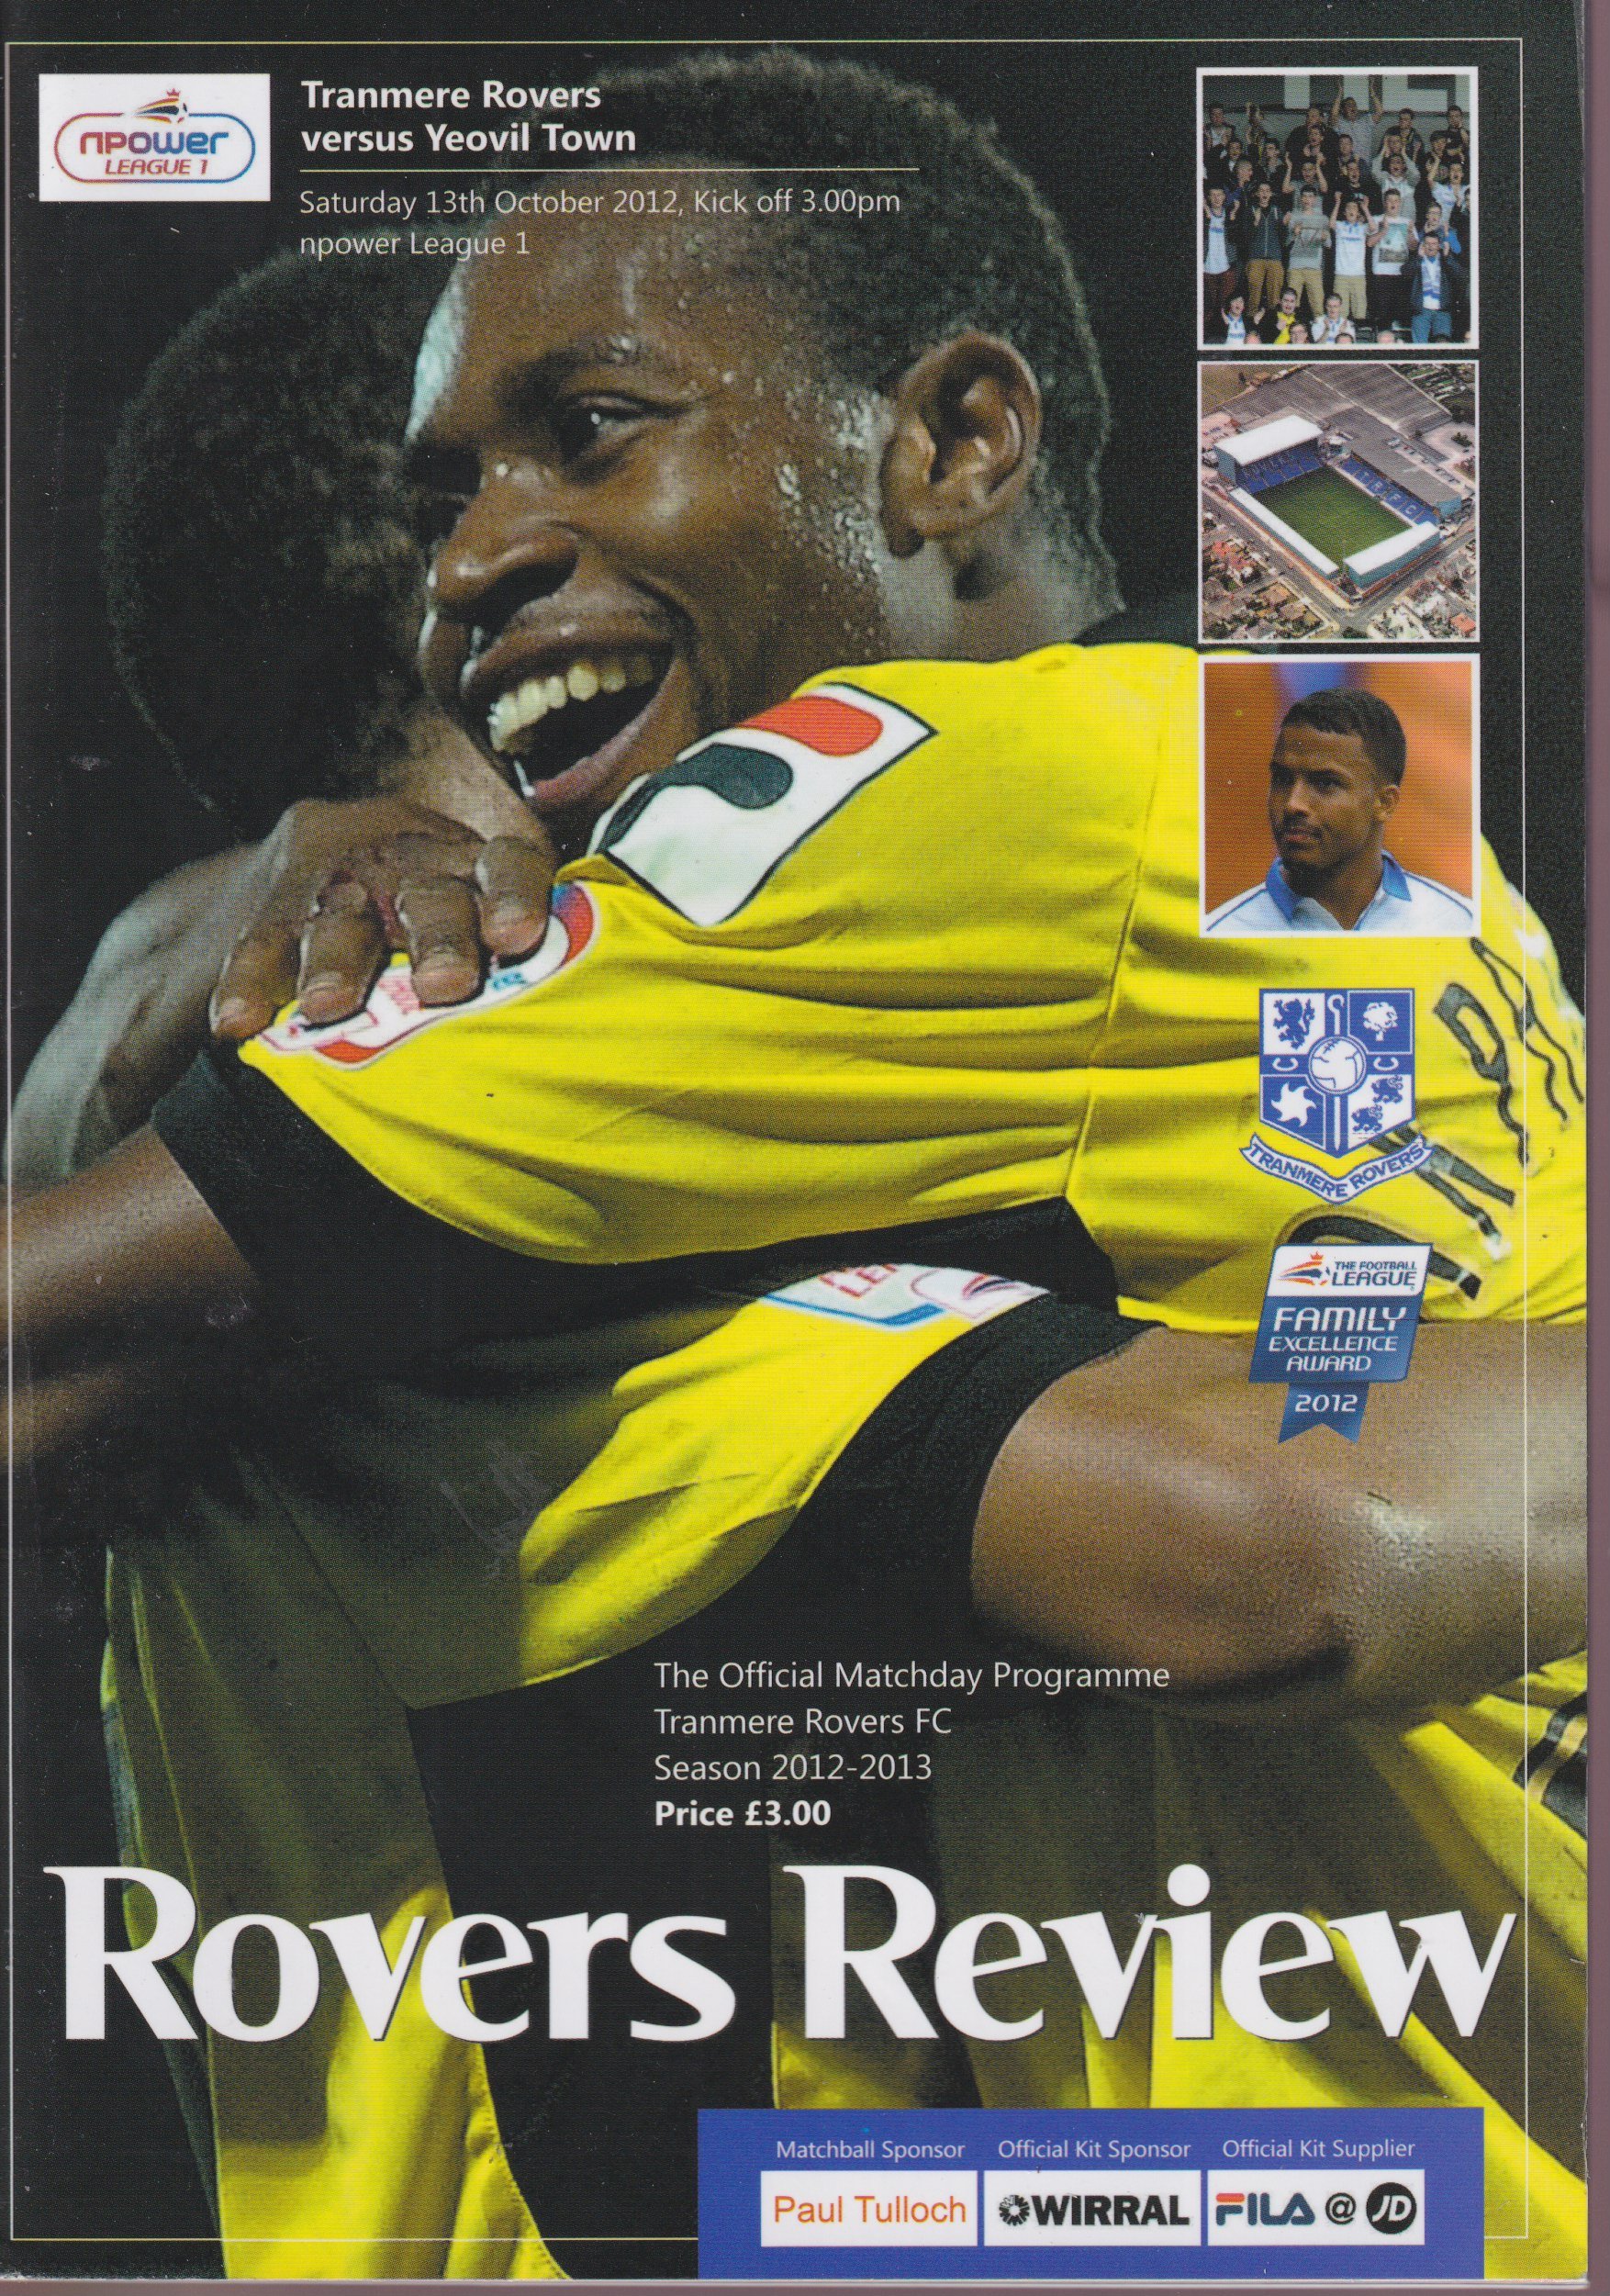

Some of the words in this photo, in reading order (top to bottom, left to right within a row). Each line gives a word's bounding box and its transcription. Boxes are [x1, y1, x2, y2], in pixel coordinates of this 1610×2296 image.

[300, 80, 470, 108] Tranmere
[483, 80, 601, 108] Rovers
[301, 129, 414, 152] versus
[424, 122, 530, 151] Yeovil
[540, 123, 636, 151] Town
[105, 160, 191, 175] LEAGUE
[199, 160, 209, 175] 1
[300, 189, 417, 221] Saturday
[427, 189, 485, 214] 13th
[495, 189, 604, 214] October
[613, 190, 683, 218] 2012,
[695, 188, 748, 214] Kick
[756, 188, 793, 214] off
[802, 189, 900, 220] 3.00pm
[300, 237, 401, 263] npower
[410, 231, 507, 263] League
[516, 231, 531, 254] 1
[1249, 1142, 1348, 1198] TRANMERE
[1348, 1144, 1426, 1191] ROVERS
[1331, 1271, 1417, 1286] LEAGUE
[1334, 1260, 1358, 1271] THE
[1359, 1260, 1418, 1271] FOOTBALL
[1273, 1307, 1407, 1332] FAMILY
[1269, 1336, 1400, 1352] EXCELLENCE
[1286, 1355, 1372, 1372] AWARD
[1294, 1394, 1358, 1413] 2012
[654, 1661, 709, 1688] The
[720, 1661, 823, 1688] Official
[835, 1661, 983, 1696] Matchday
[994, 1662, 1170, 1696] Programme
[654, 1708, 795, 1734] Tranmere
[806, 1708, 904, 1734] Rovers
[916, 1708, 953, 1734] FC
[654, 1754, 761, 1781] Season
[772, 1753, 932, 1780] 2012-2013
[655, 1799, 734, 1826] Price
[744, 1799, 832, 1826] £3.00
[43, 1866, 736, 2042] Rovers
[783, 1864, 1516, 2041] Review
[777, 2140, 875, 2158] Matchball
[882, 2140, 966, 2163] Sponsor
[998, 2139, 1068, 2158] Official
[1076, 2140, 1102, 2157] Kit
[1108, 2140, 1191, 2163] Sponsor
[1223, 2139, 1292, 2157] Official
[1301, 2140, 1325, 2157] Kit
[1333, 2138, 1415, 2162] Supplier
[773, 2194, 844, 2226] Paul
[853, 2194, 968, 2226] Tulloch
[1031, 2194, 1191, 2226] WIRRAL
[1215, 2192, 1316, 2226] FILA
[1371, 2195, 1414, 2223] JD
